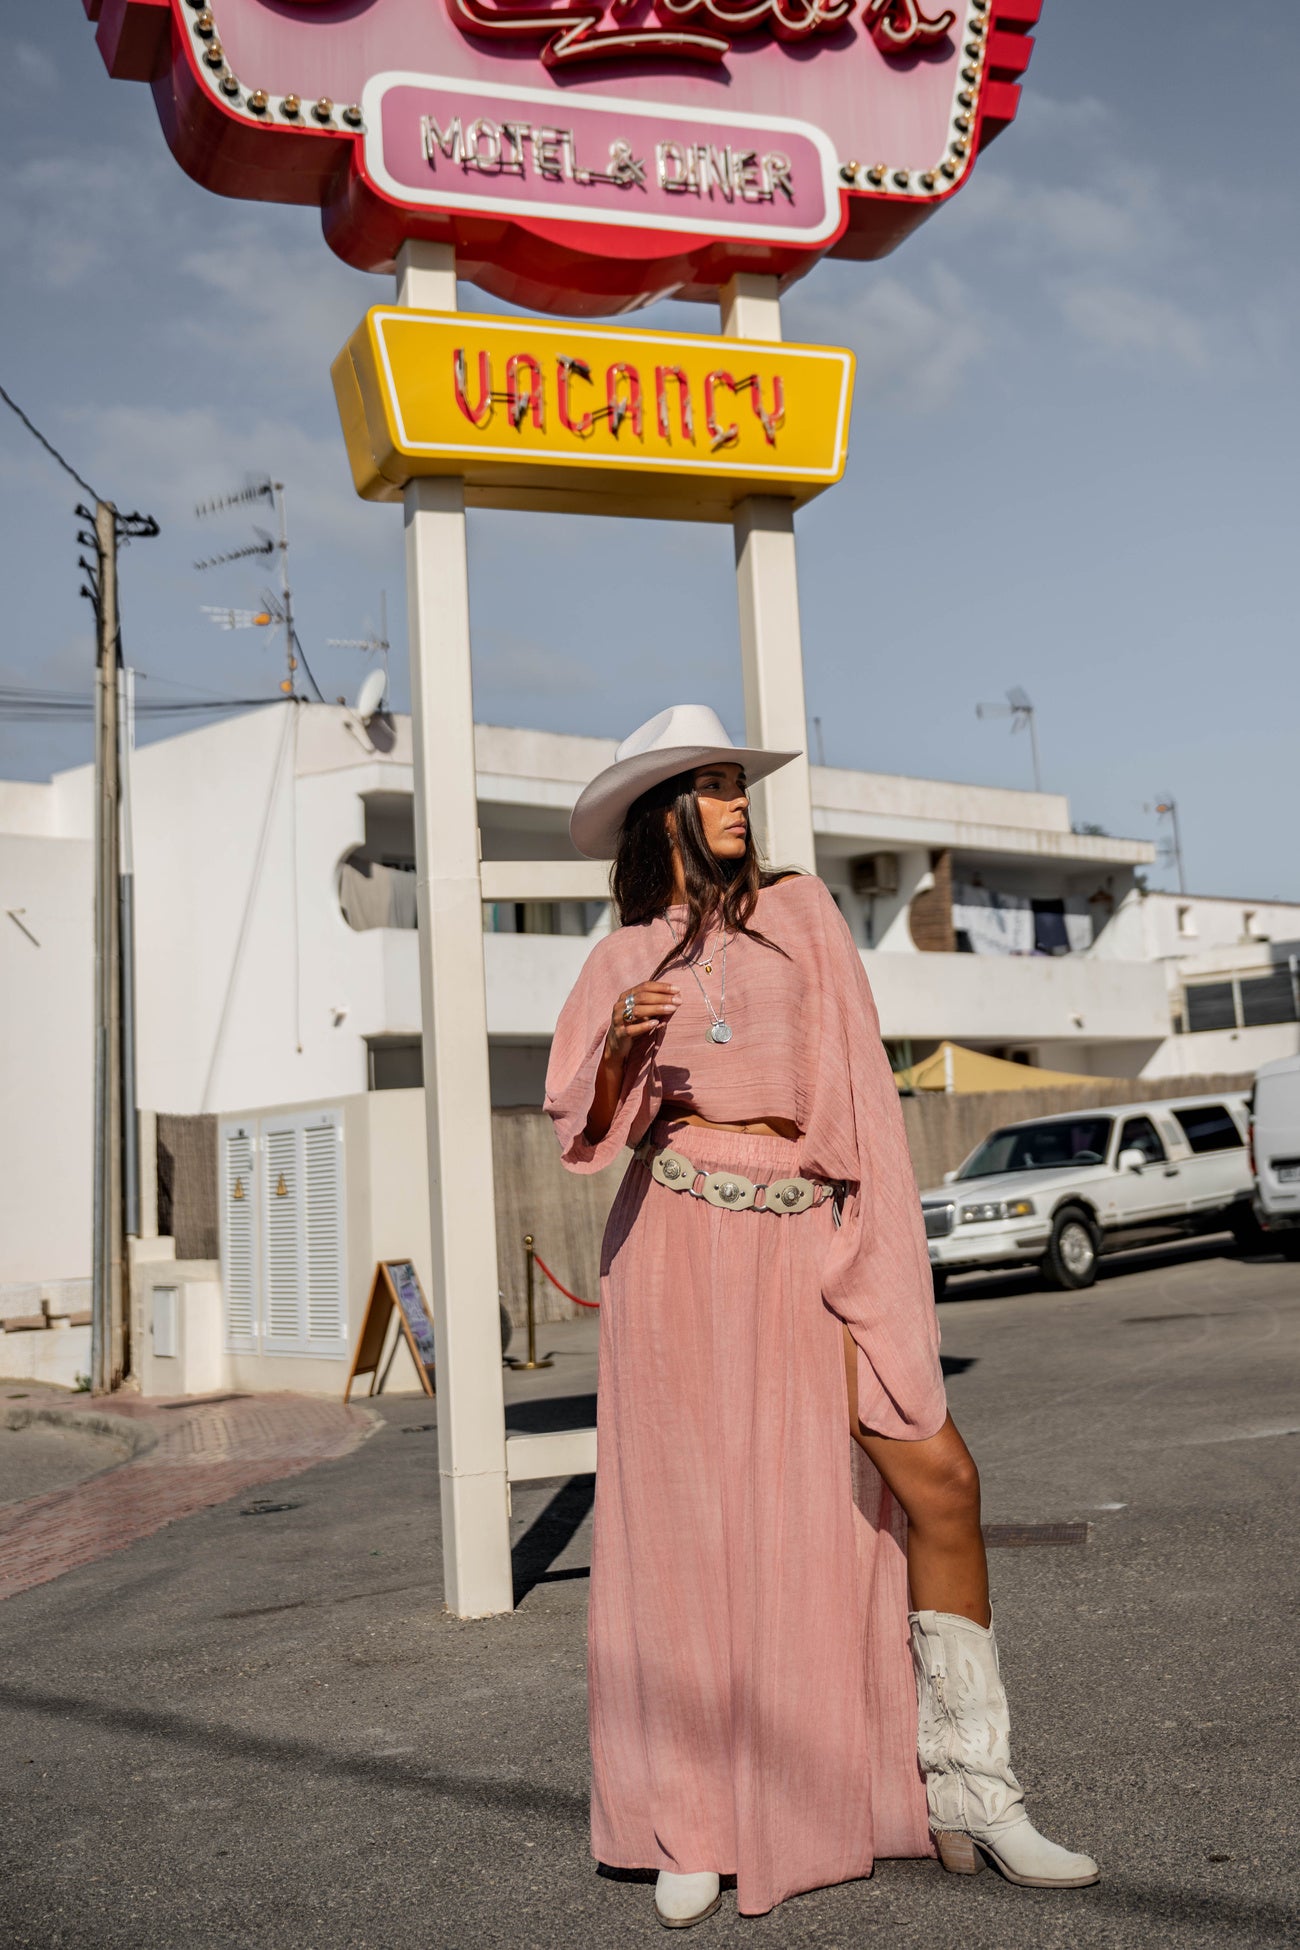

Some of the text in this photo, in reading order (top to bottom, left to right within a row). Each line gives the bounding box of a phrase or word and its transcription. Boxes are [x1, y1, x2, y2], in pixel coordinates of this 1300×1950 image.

[420, 115, 794, 204] MOTEL & DINER
[453, 348, 785, 447] VACANCY
